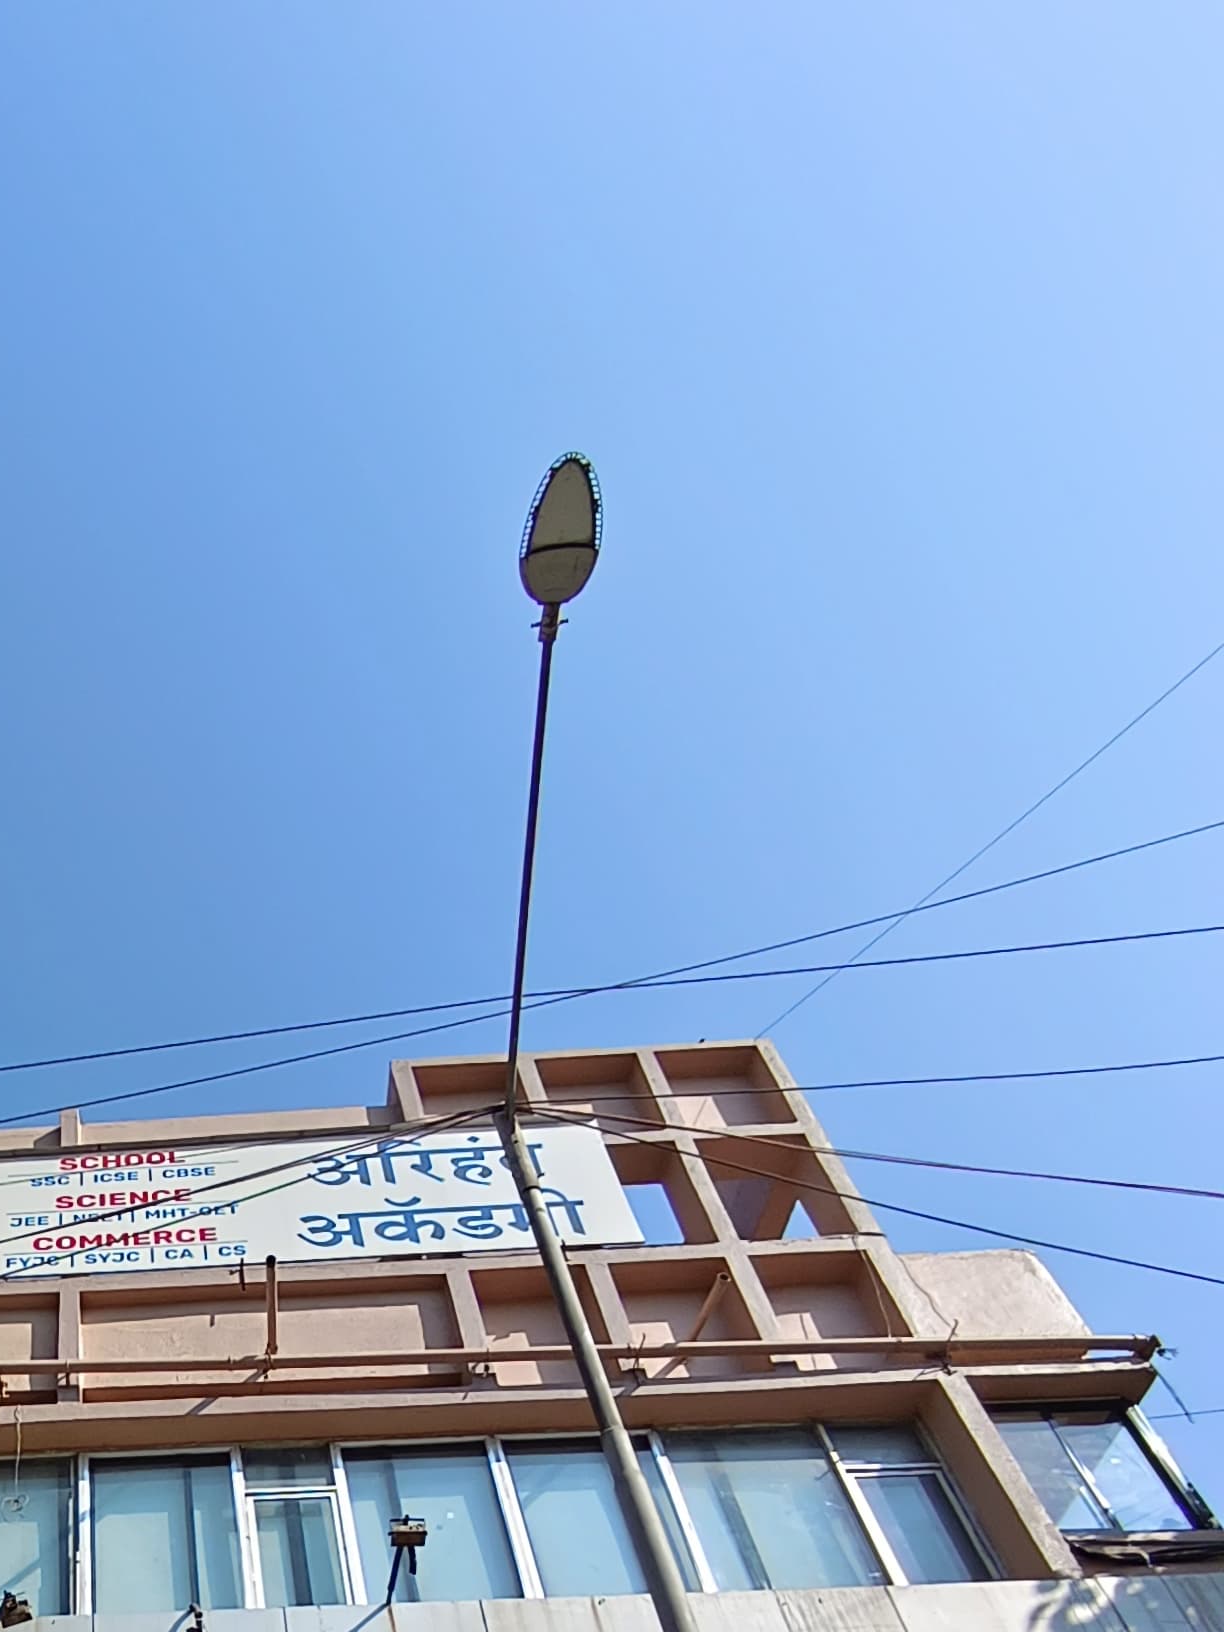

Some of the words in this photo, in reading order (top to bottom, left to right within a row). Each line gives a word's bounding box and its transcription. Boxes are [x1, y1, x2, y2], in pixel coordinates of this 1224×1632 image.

[59, 1152, 186, 1171] SCHOOL
[30, 1175, 71, 1187] SSC
[93, 1171, 139, 1183] ICSE
[162, 1166, 216, 1179] CBSE
[55, 1189, 193, 1209] SCIENCE
[10, 1216, 49, 1228] JEE
[145, 1203, 239, 1220] MHT-CET
[33, 1227, 218, 1251] COMMERCE
[6, 1254, 60, 1269] FYJC
[84, 1251, 140, 1265] SYJC
[165, 1248, 194, 1260] CA
[218, 1245, 247, 1257] CS
